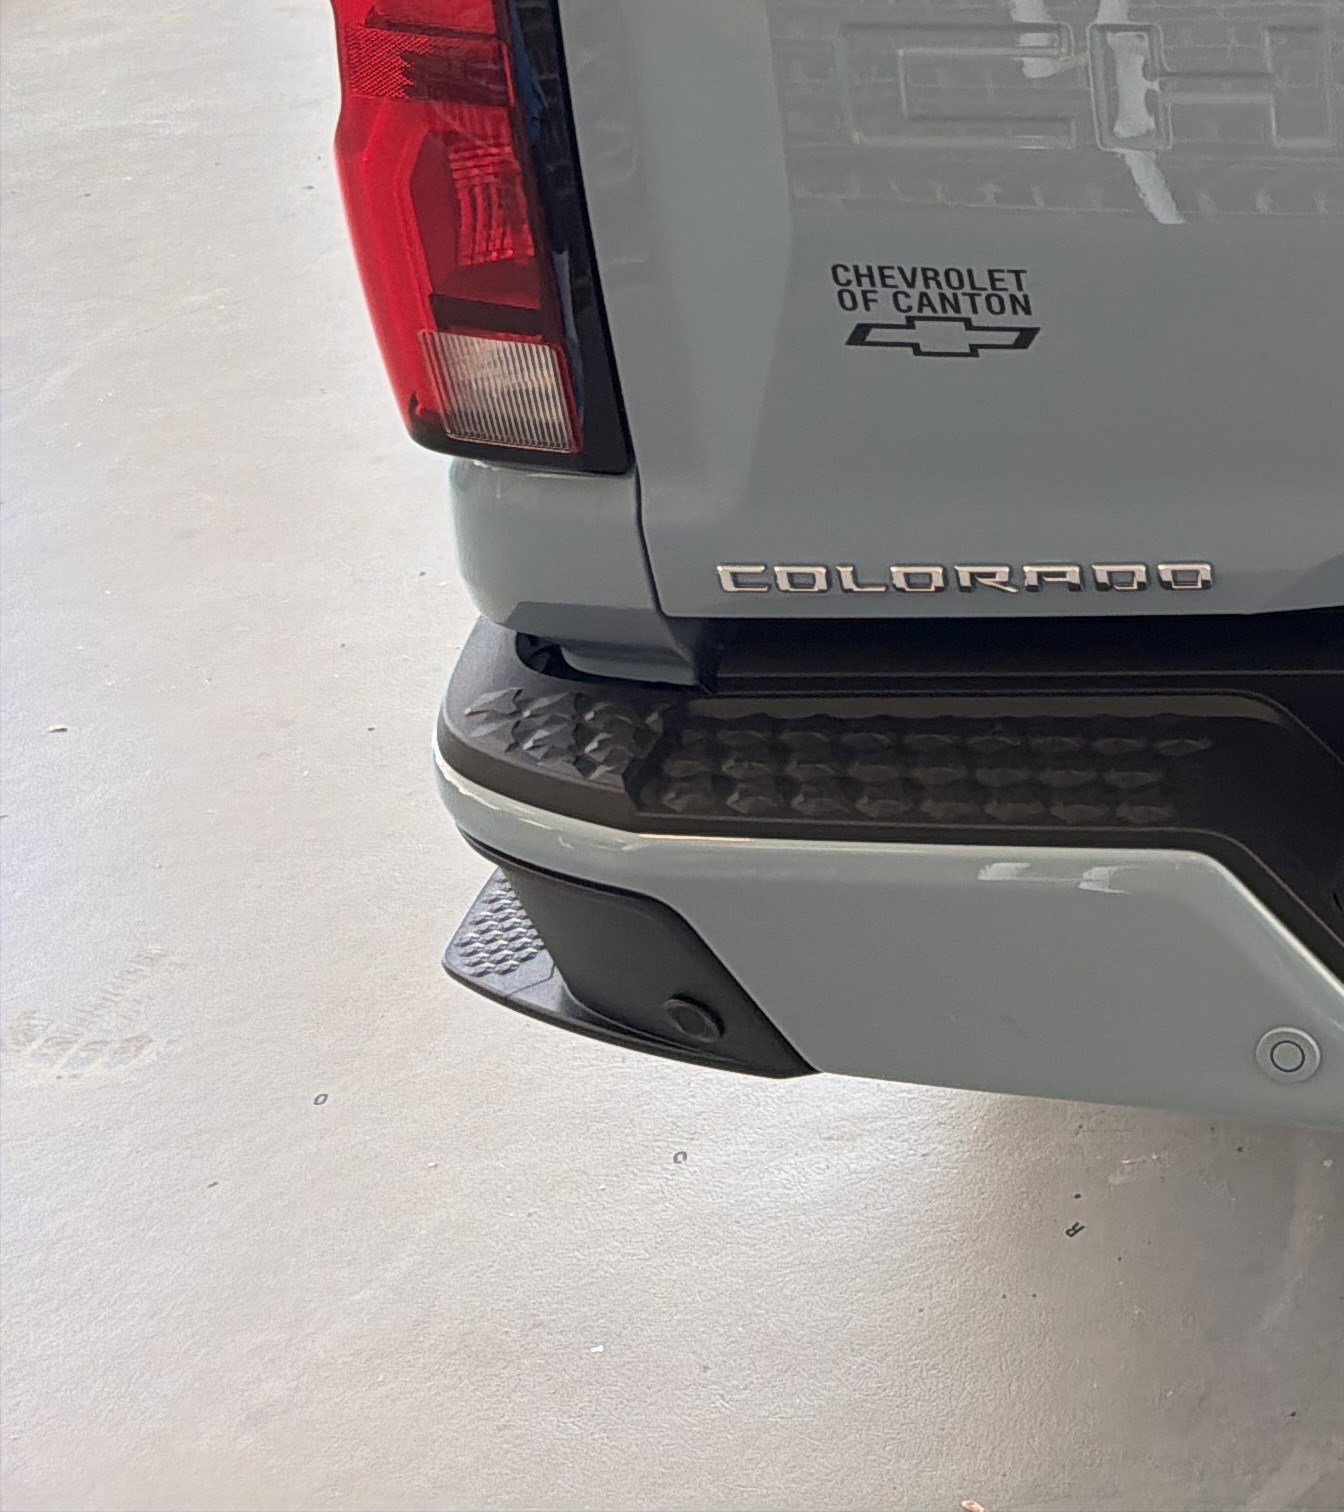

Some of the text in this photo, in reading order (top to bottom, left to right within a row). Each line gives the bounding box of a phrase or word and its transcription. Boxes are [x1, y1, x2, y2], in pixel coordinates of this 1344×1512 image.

[831, 263, 1027, 292] CHEVROLET
[837, 288, 1032, 316] OF CANTON
[716, 562, 1212, 593] COLORADO
